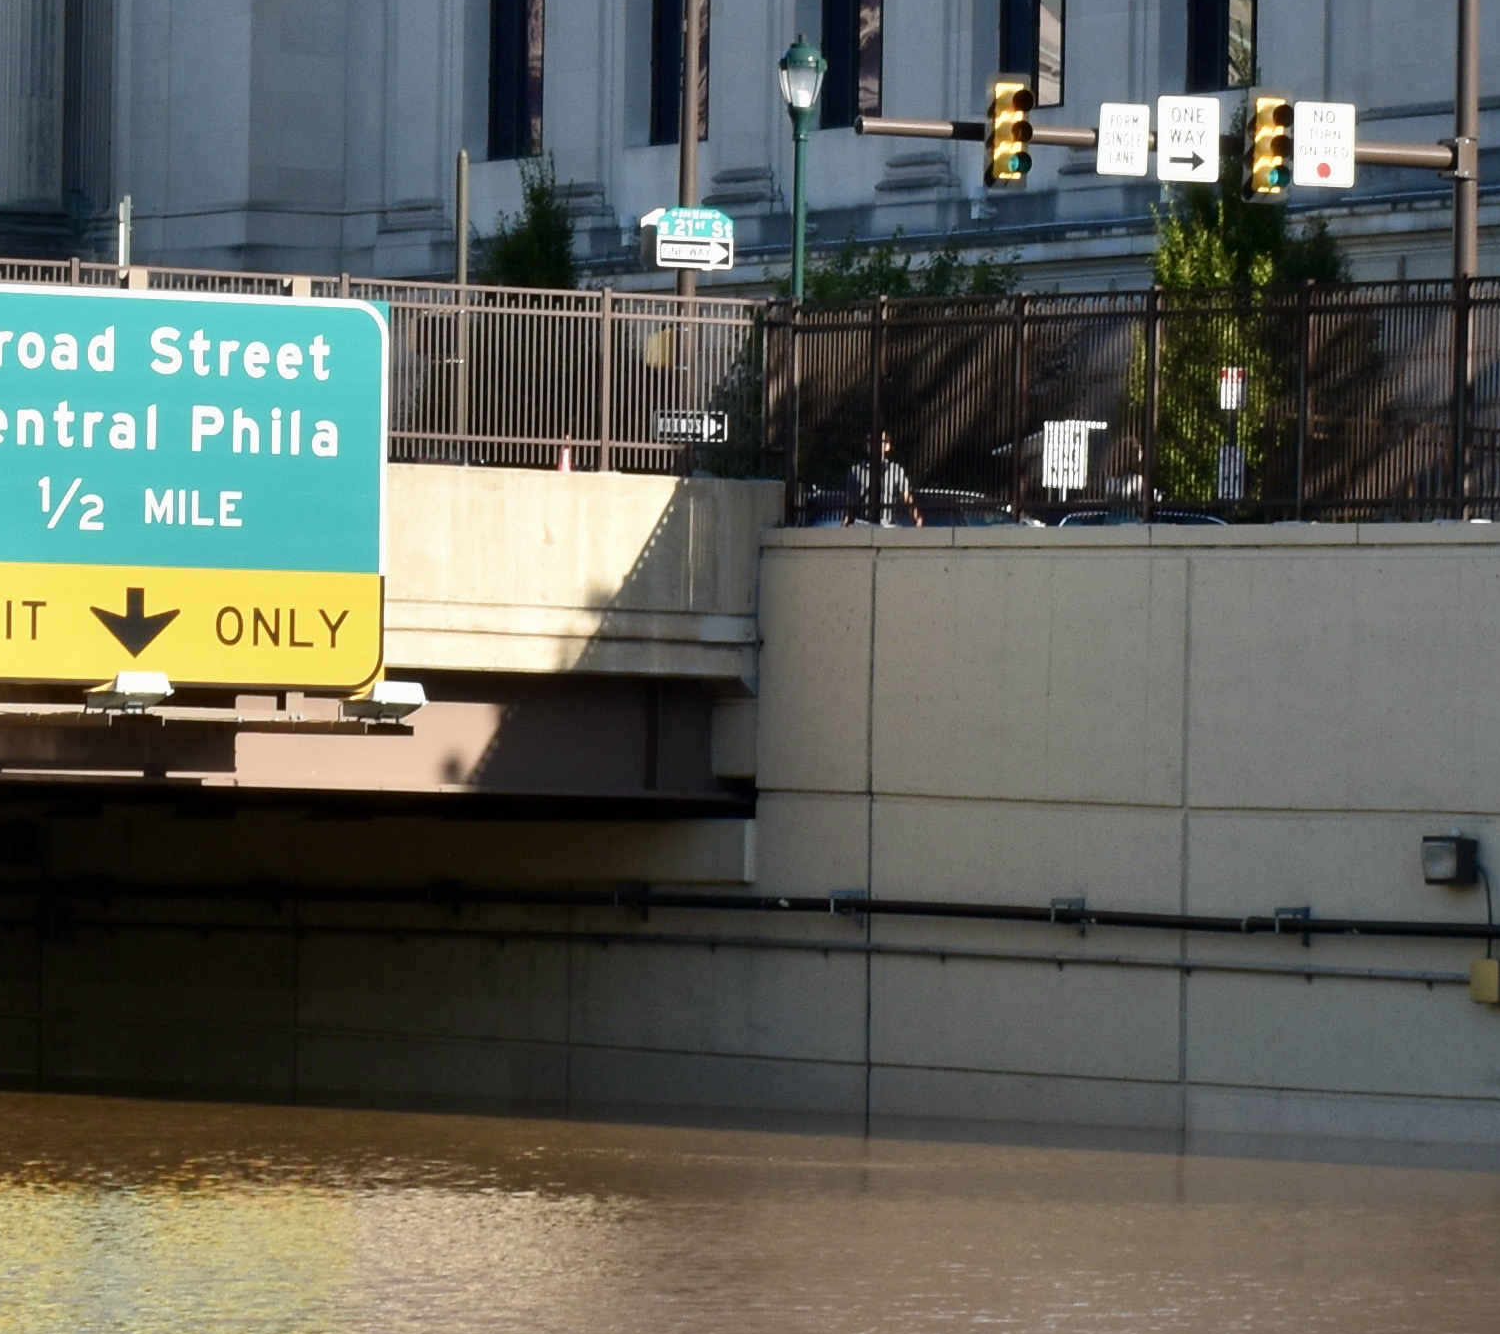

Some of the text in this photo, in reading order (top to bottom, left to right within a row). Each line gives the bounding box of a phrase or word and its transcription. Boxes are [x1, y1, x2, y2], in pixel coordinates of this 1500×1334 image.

[1110, 114, 1139, 128] FORM
[1171, 107, 1205, 124] ONE
[1313, 110, 1336, 124] NO
[1105, 132, 1141, 148] SINGLE
[1170, 129, 1206, 145] WAY
[1310, 128, 1341, 140] TURN
[1108, 151, 1135, 165] LANE
[1299, 145, 1349, 158] ON RED
[711, 220, 734, 238] St
[150, 326, 331, 381] Street
[191, 404, 339, 457] Phila
[144, 488, 243, 527] MILE
[215, 605, 350, 649] ONLY
